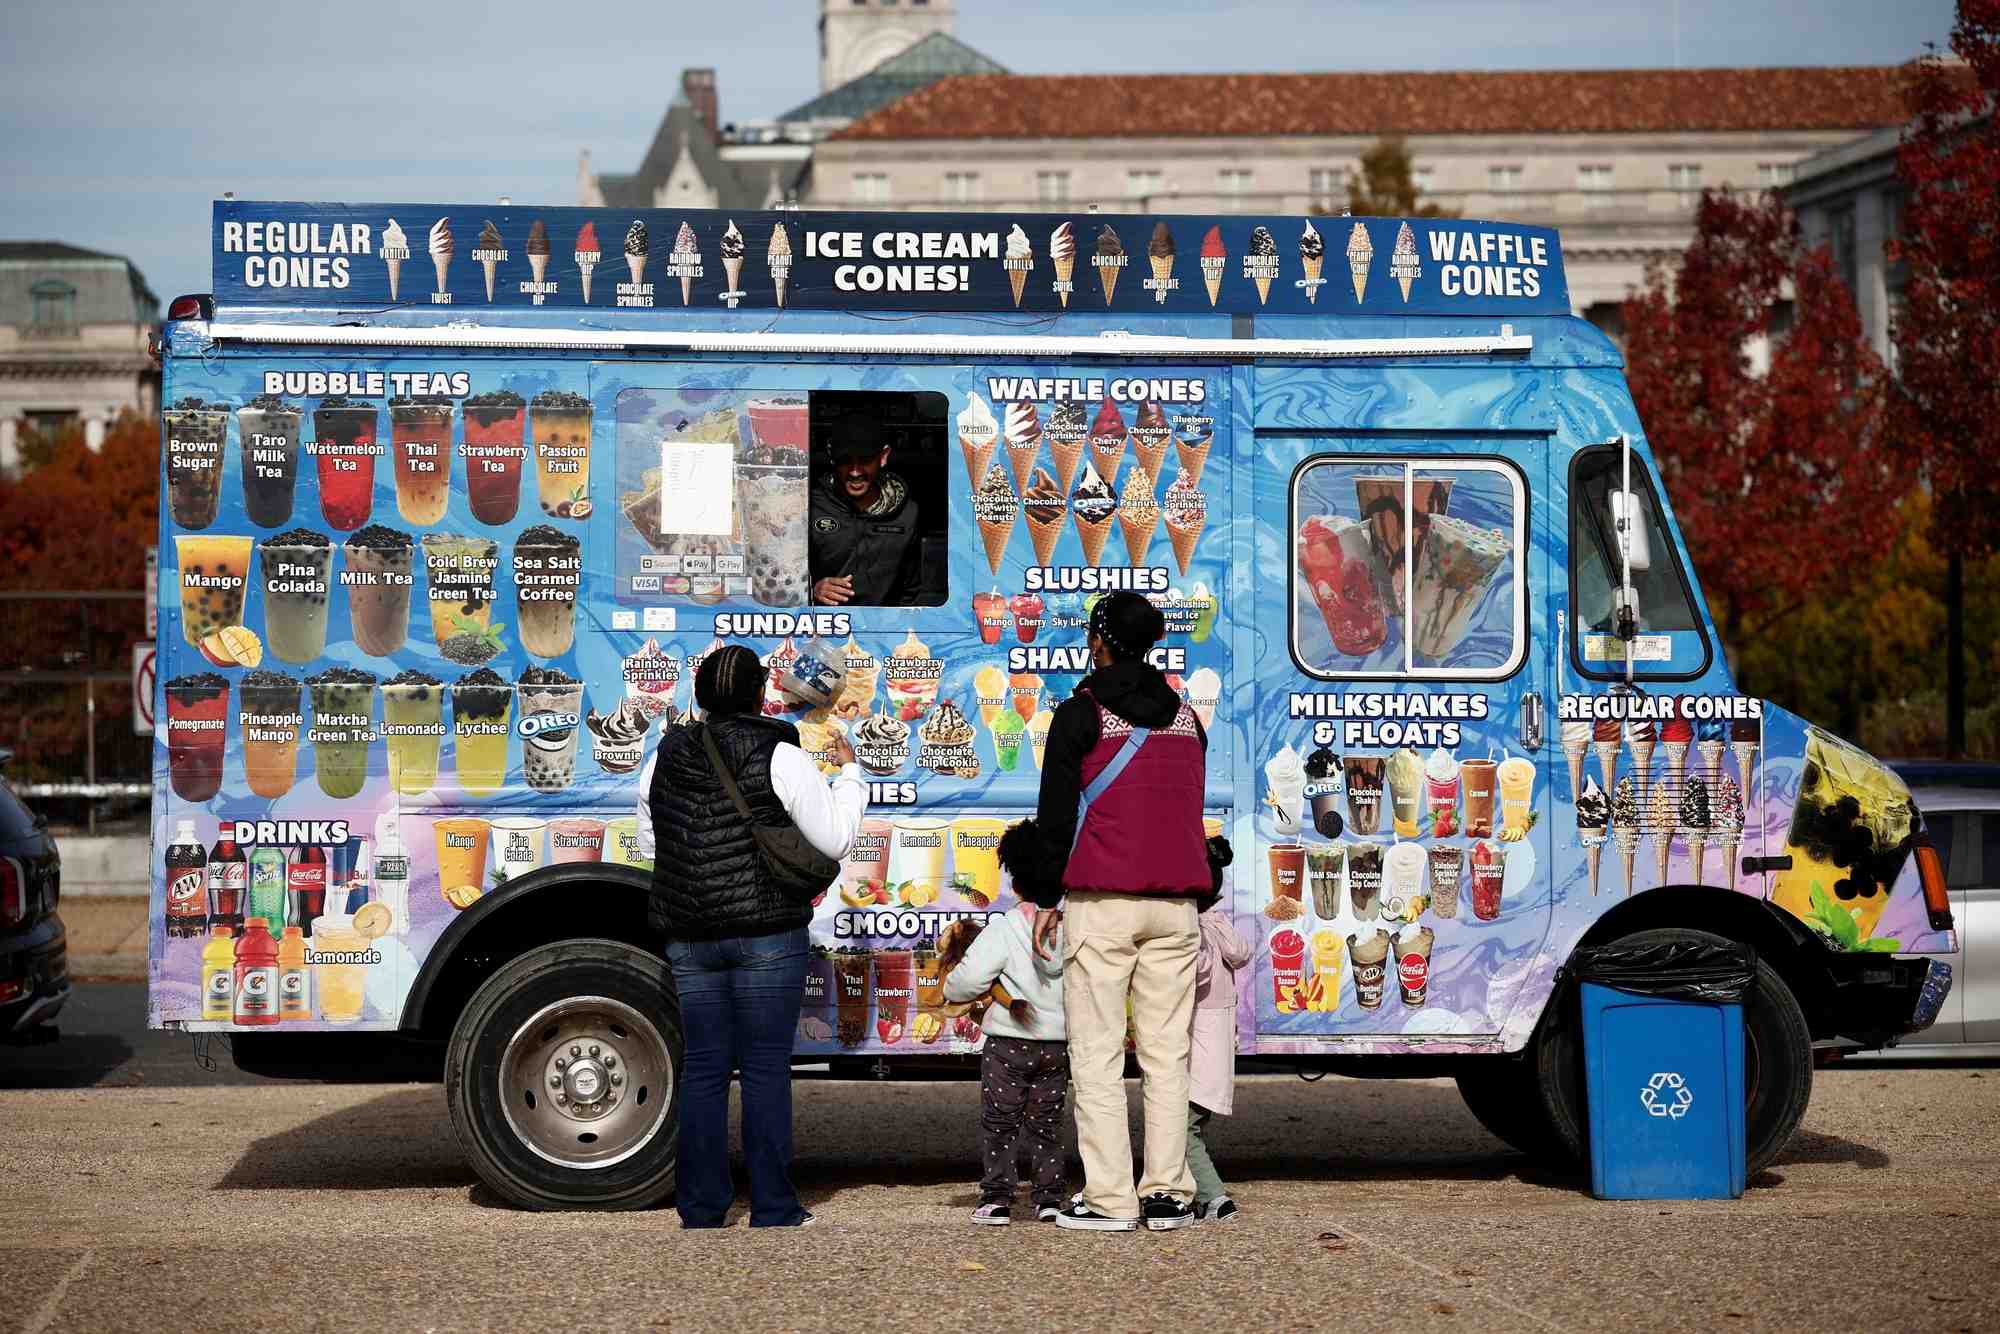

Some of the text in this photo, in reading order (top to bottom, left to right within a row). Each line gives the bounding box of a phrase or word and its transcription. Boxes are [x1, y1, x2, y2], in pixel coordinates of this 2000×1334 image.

[223, 221, 371, 254] REGULAR
[805, 231, 998, 258] ICE CREAM
[1428, 231, 1548, 266] WAFFLE
[379, 248, 411, 260] VANILLA
[472, 249, 509, 261] CHOCOLATE
[574, 251, 601, 263] CHERRY
[669, 253, 702, 265] RAINBOW
[767, 255, 793, 266] PEANUT
[1243, 255, 1280, 266] CHOCOLATE
[1391, 254, 1420, 265] RAINBOW
[1003, 259, 1034, 270] VANILLA
[1091, 255, 1129, 267] CHOCOLATE
[1200, 257, 1226, 268] CHERRY
[244, 256, 351, 289] CONES
[667, 265, 704, 277] SPRINKLES
[1243, 267, 1279, 278] SPRINKLES
[1390, 267, 1422, 278] SPRINKLES
[834, 265, 969, 291] CONES!
[1143, 278, 1180, 290] CHOCOLATE
[1441, 264, 1541, 297] CONES
[520, 281, 558, 293] CHOCOLATE
[616, 283, 654, 295] CHOCOLATE
[1052, 281, 1074, 292] SWIRL
[431, 293, 452, 304] TWIST
[533, 294, 545, 305] DIP
[616, 295, 654, 307] SPRINKLES
[264, 371, 470, 397] BUBBLE TEAS
[988, 378, 1206, 402] WAFFLE CONES
[1172, 415, 1215, 424] Blueberry
[1043, 423, 1088, 431] Chocolate
[1128, 426, 1173, 434] Chocolate
[1186, 424, 1201, 433] Dip
[252, 433, 287, 446] Taro
[1045, 431, 1087, 440] Sprinkles
[1092, 437, 1122, 446] Cherry
[1142, 436, 1158, 444] Dip
[170, 439, 218, 452] Brown
[305, 442, 385, 456] Watermelon
[405, 443, 438, 456] Thai
[458, 444, 529, 459] Strawberry
[539, 444, 587, 457] Passion
[1011, 441, 1034, 449] Swirl
[1100, 446, 1115, 455] Dip
[253, 448, 286, 462] Milk
[172, 455, 215, 470] Sugar
[332, 458, 357, 471] Tea
[408, 458, 435, 472] Tea
[482, 459, 506, 473] Tea
[547, 459, 579, 473] Fruit
[255, 465, 283, 478] Tea
[970, 495, 1019, 503] Chocolate
[1165, 491, 1206, 499] Rainbow
[974, 504, 991, 513] Dip
[975, 513, 1015, 521] Peanuts
[427, 555, 499, 569] Cold Brew
[513, 556, 581, 569] Sea Salt
[278, 563, 316, 577] Pina
[183, 573, 242, 590] Mango
[339, 571, 413, 585] Milk Tea
[434, 571, 491, 584] Jasmine
[513, 572, 580, 585] Caramel
[635, 578, 658, 588] VISA
[1024, 567, 1168, 591] SLUSHIES
[267, 579, 326, 593] Colada
[428, 587, 497, 600] Green Tea
[519, 588, 574, 601] Coffee
[1151, 599, 1210, 608] ream Slushies
[1186, 611, 1199, 619] Ice
[714, 612, 851, 636] SUNDAES
[983, 617, 1012, 627] Mango
[1018, 617, 1047, 628] Cherry
[1052, 617, 1068, 628] Sky
[1165, 623, 1197, 632] Flavor
[624, 658, 679, 668] Rainbow
[883, 656, 944, 669] Strawberry
[1008, 647, 1185, 671] SHAV CE
[623, 670, 680, 682] Sprinkles
[886, 667, 941, 679] Shortcake
[1289, 692, 1489, 719] MILKSHAKES
[1560, 696, 1763, 720] REGULAR CONES
[168, 717, 225, 733] Pomegranate
[239, 712, 304, 727] Pineapple
[316, 713, 369, 726] Matcha
[517, 711, 581, 738] OREO
[380, 722, 447, 735] Lemonade
[455, 721, 507, 738] Lychee
[1313, 721, 1461, 747] & FLOATS
[249, 729, 294, 743] Mango
[307, 729, 377, 742] Green Tea
[593, 749, 642, 760] Brownie
[854, 746, 910, 757] Chocolate
[920, 746, 973, 757] Chocolate
[871, 758, 894, 768] Nut
[915, 758, 979, 769] Chip Cookie
[1303, 783, 1343, 798] OREO
[1349, 787, 1383, 796] Chocolate
[234, 820, 350, 846] DRINKS
[509, 832, 529, 847] Pina
[900, 832, 941, 847] Lemonade
[446, 832, 475, 848] Mango
[554, 832, 600, 849] Strawberry
[855, 832, 888, 849] awberry
[958, 832, 1000, 849] Pineapple
[505, 848, 534, 862] Colada
[850, 848, 881, 861] Banana
[1351, 871, 1381, 879] Chocolate
[834, 911, 1006, 938] SMOOTH
[304, 948, 382, 965] Lemonade
[845, 975, 864, 985] Thai
[846, 987, 862, 996] Tea
[874, 987, 913, 999] Strawberry
